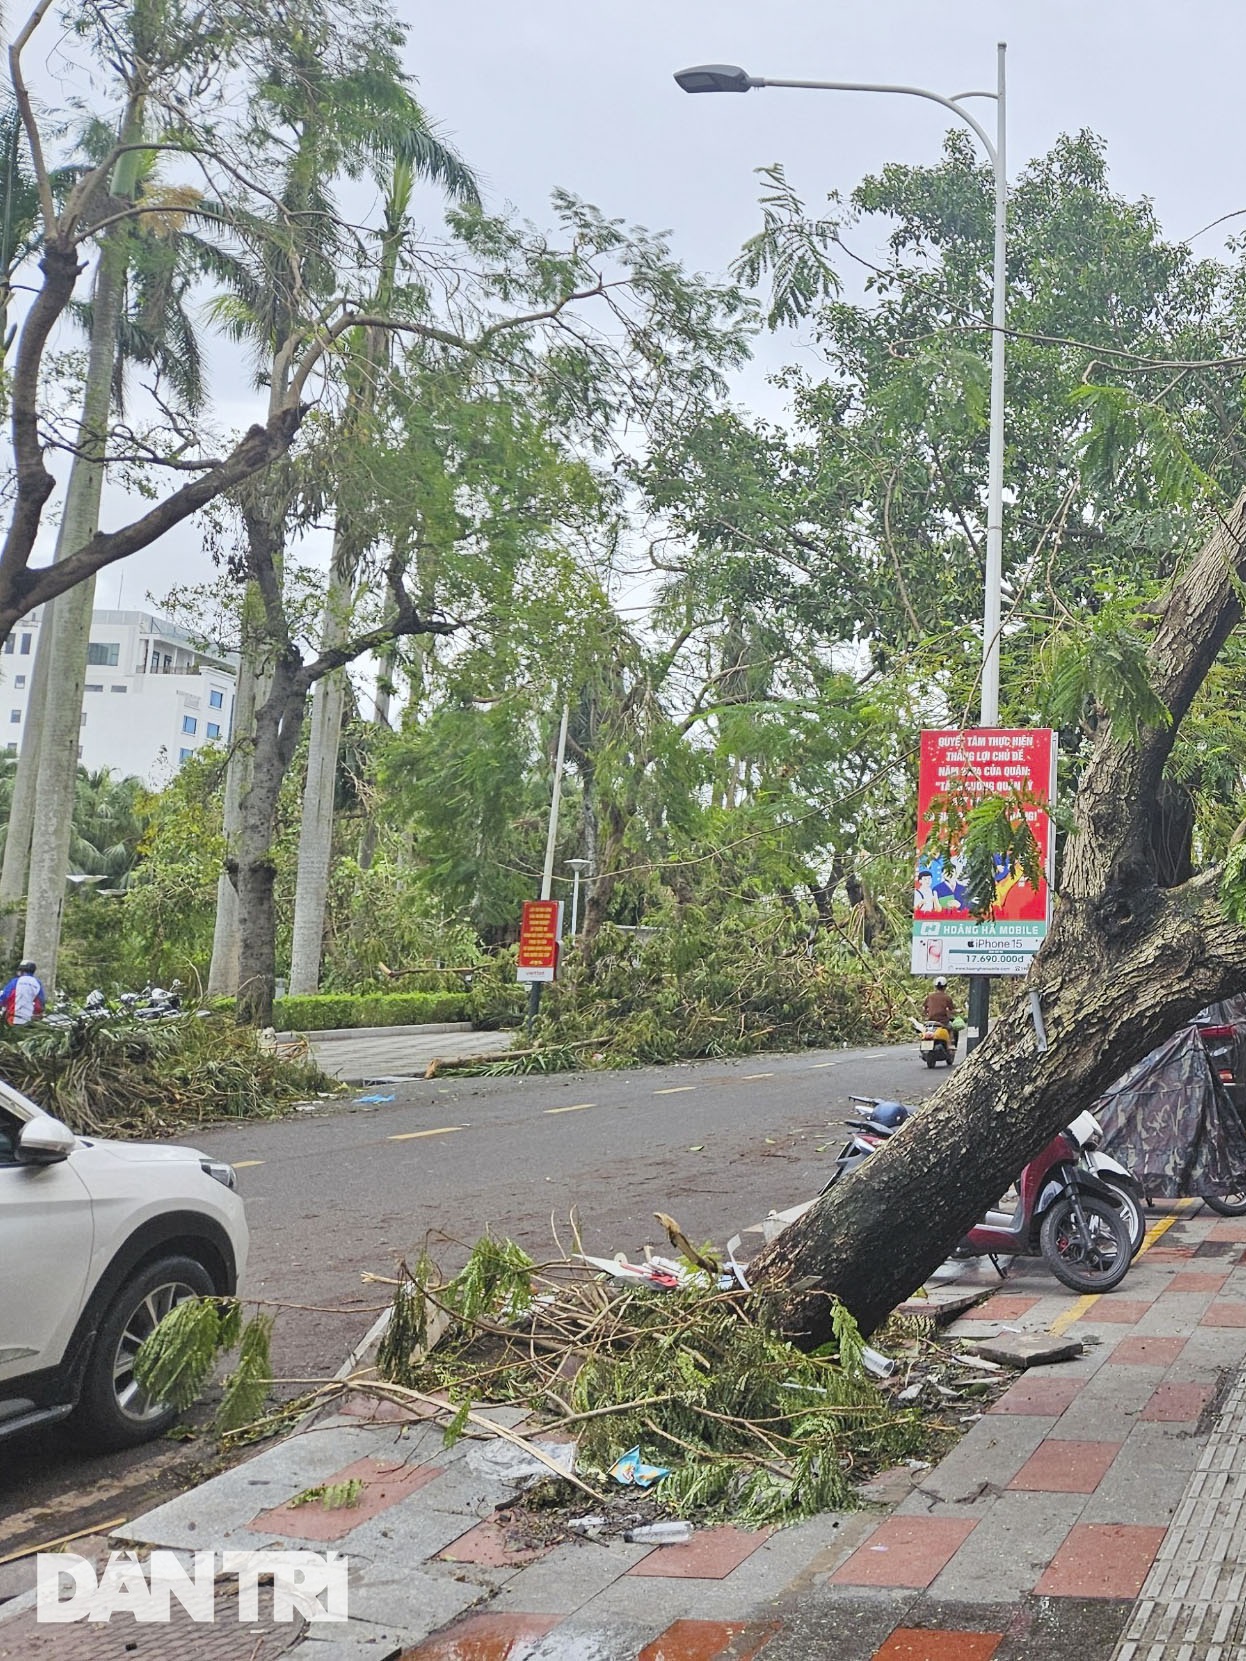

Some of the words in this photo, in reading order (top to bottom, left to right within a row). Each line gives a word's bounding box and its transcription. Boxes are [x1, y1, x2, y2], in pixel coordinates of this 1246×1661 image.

[938, 735, 963, 747] QUYẾ
[967, 735, 986, 746] TÂM
[988, 736, 1012, 747] THỰC
[1012, 735, 1034, 747] HIỆN
[976, 751, 990, 763] LỢI
[992, 749, 1010, 761] CHỦ
[984, 764, 1001, 776] CỦA
[943, 924, 979, 935] HOÀNG
[982, 924, 996, 935] HÀ
[1000, 925, 1039, 935] MOBILE
[975, 939, 1010, 949] iPhone
[1013, 939, 1023, 949] 15
